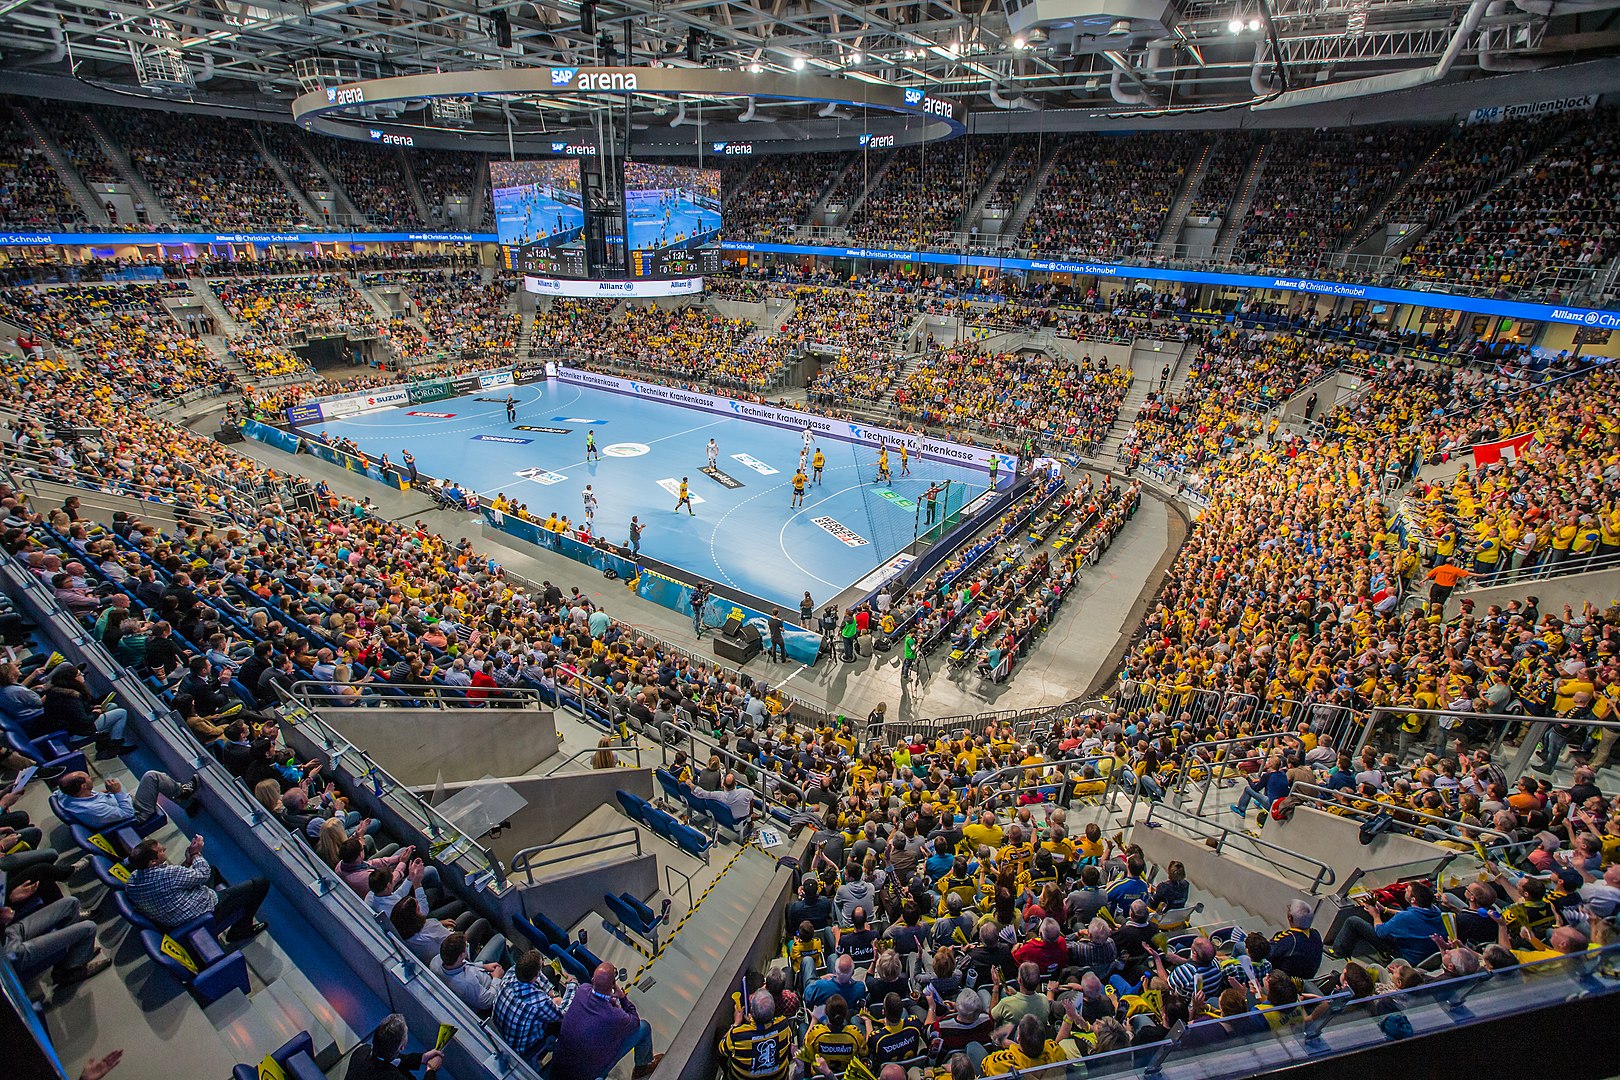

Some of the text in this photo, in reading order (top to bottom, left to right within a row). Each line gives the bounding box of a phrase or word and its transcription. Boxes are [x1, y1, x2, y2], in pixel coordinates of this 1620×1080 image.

[551, 70, 637, 90] SAP arena
[326, 87, 364, 104] SAP arena
[905, 90, 953, 118] SAP arena
[1475, 95, 1593, 119] DKB-Familienblock
[370, 130, 414, 146] SAP arena
[870, 135, 894, 148] arena
[552, 143, 596, 155] SAP arena
[713, 143, 752, 155] SAP arena
[9, 235, 52, 243] Schnubel
[535, 249, 548, 258] 1:24
[672, 250, 685, 261] 1:24
[865, 250, 888, 258] Christian
[888, 252, 912, 260] Schnubel
[1056, 263, 1084, 272] Christian
[1085, 265, 1117, 274] Schnubel
[599, 281, 624, 290] Allianz
[670, 280, 687, 289] Allianz
[1274, 279, 1365, 296] Allianz Christian Schnubel
[1551, 309, 1585, 321] Allianz
[520, 369, 543, 379] goldgas
[558, 369, 620, 389] Techniker Krankenkasse
[376, 393, 407, 403] SUZUKI
[640, 386, 669, 398] Techniker
[669, 391, 714, 407] Krankenkasse
[740, 405, 775, 420] Techniker
[776, 412, 831, 431] Krankenkasse
[906, 439, 974, 461] Krnkenkasse
[822, 516, 868, 545] WERKZEUG
[829, 1045, 852, 1053] DURAVIT
[891, 1035, 915, 1051] DURAVIT
